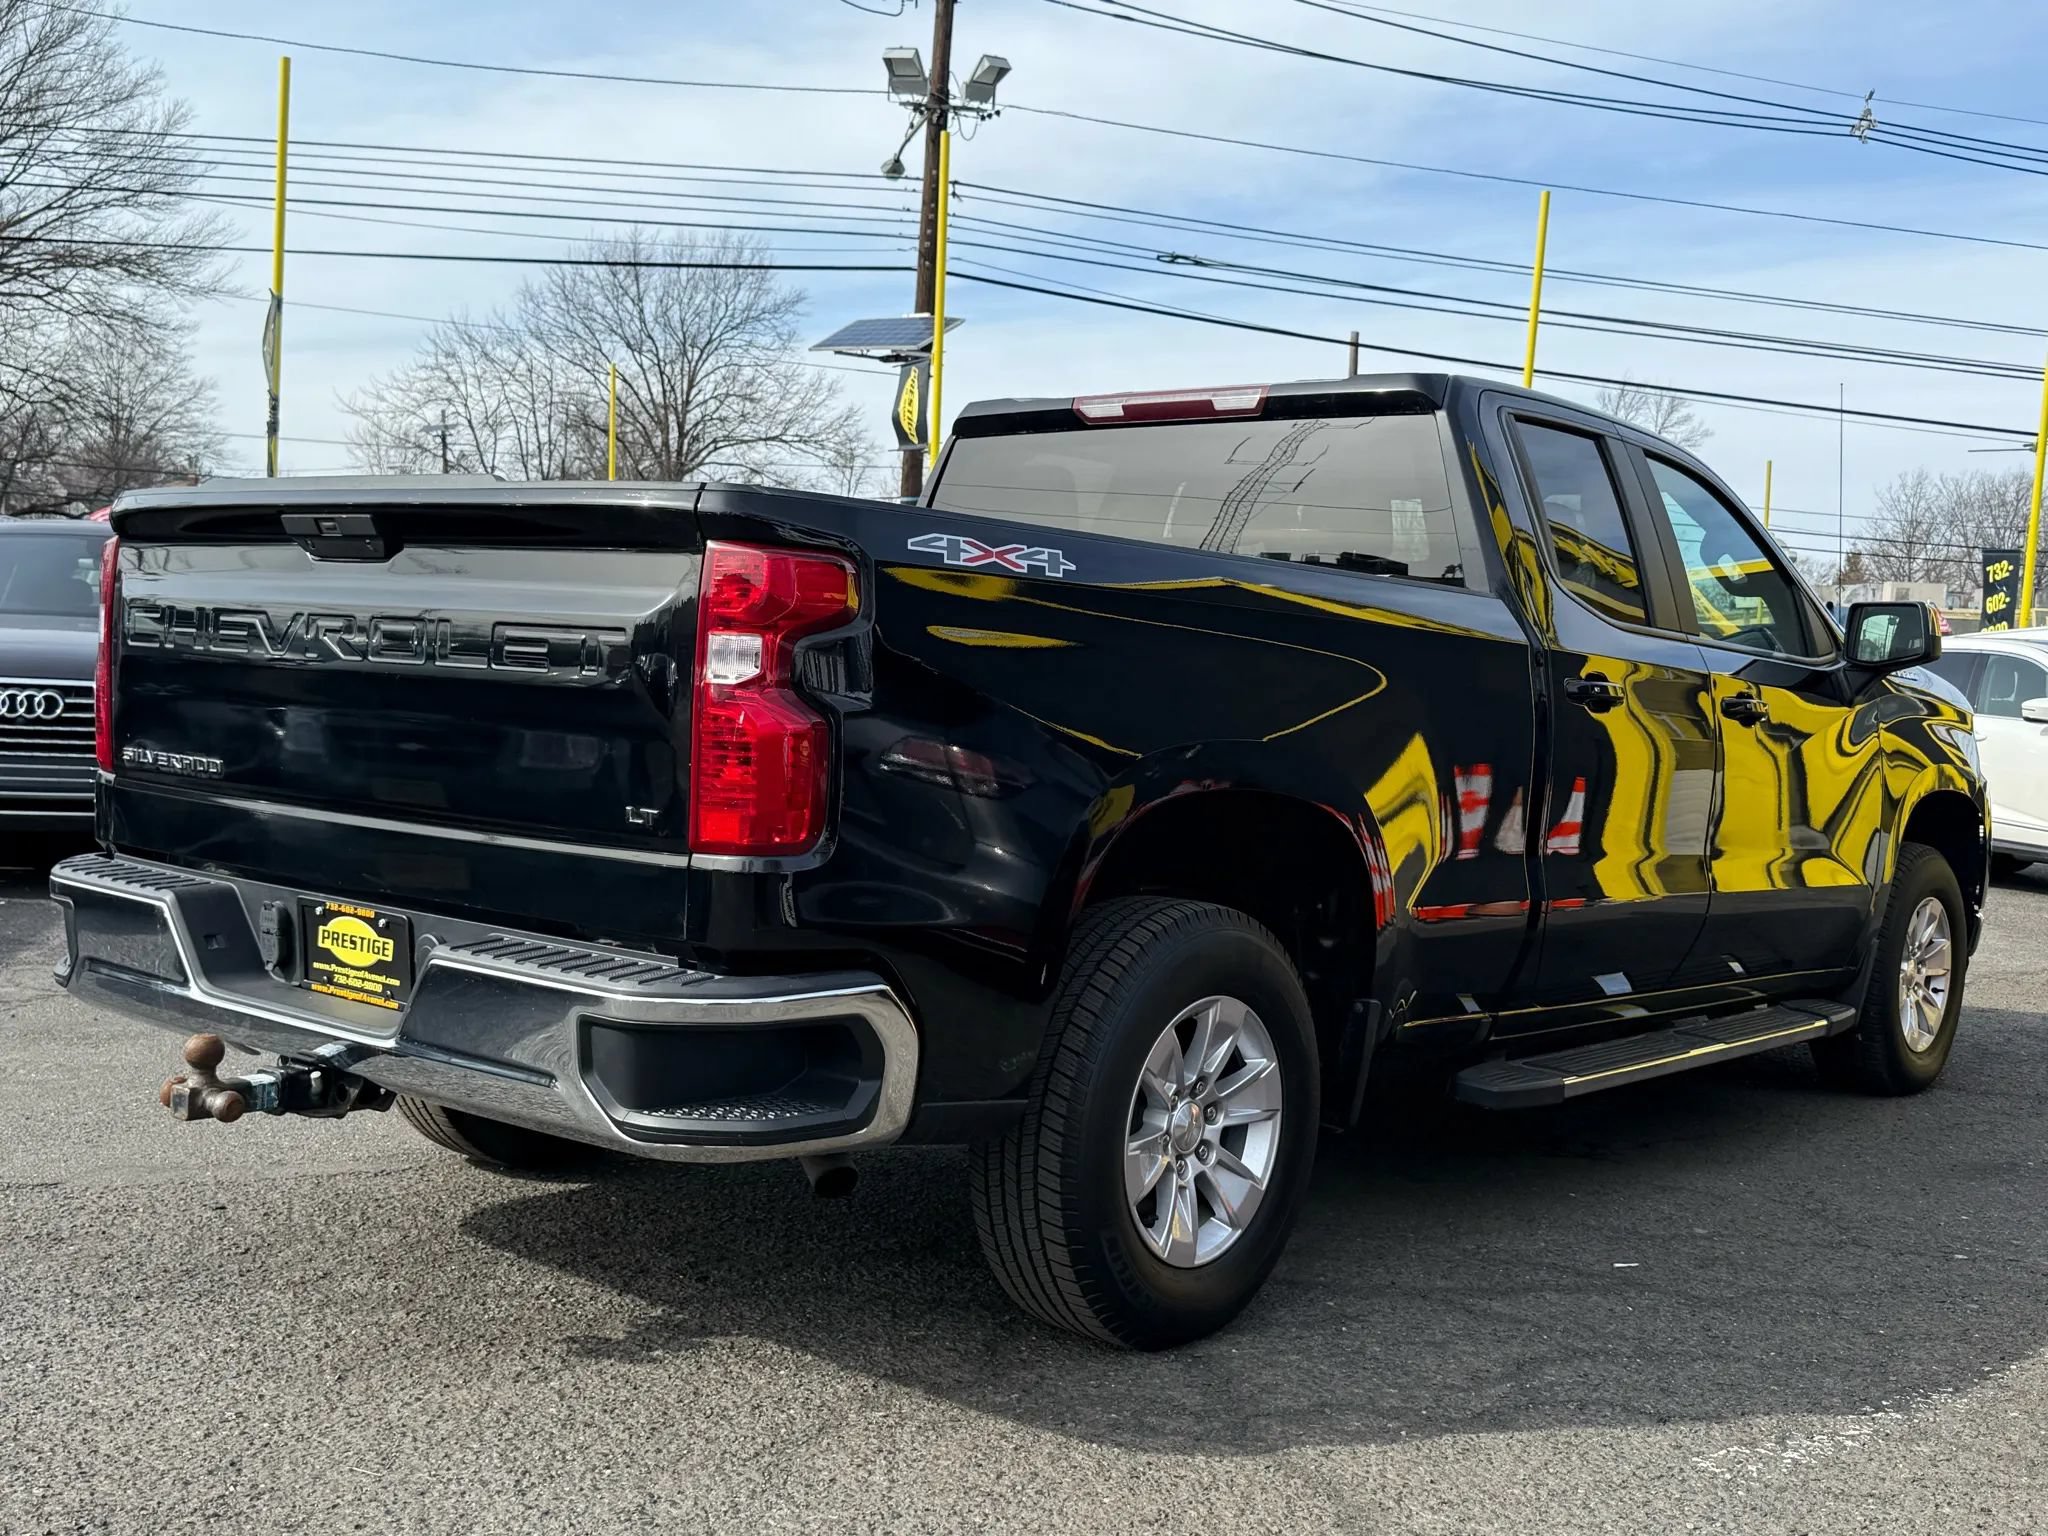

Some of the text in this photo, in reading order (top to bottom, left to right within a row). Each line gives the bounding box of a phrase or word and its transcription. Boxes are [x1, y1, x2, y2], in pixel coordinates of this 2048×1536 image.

[1986, 560, 2014, 583] 732-
[1986, 592, 2010, 614] 602-
[126, 605, 627, 676] CHEVROLET
[122, 747, 224, 774] SILVERADO
[625, 805, 660, 826] LT
[321, 929, 390, 957] PRESTIGE
